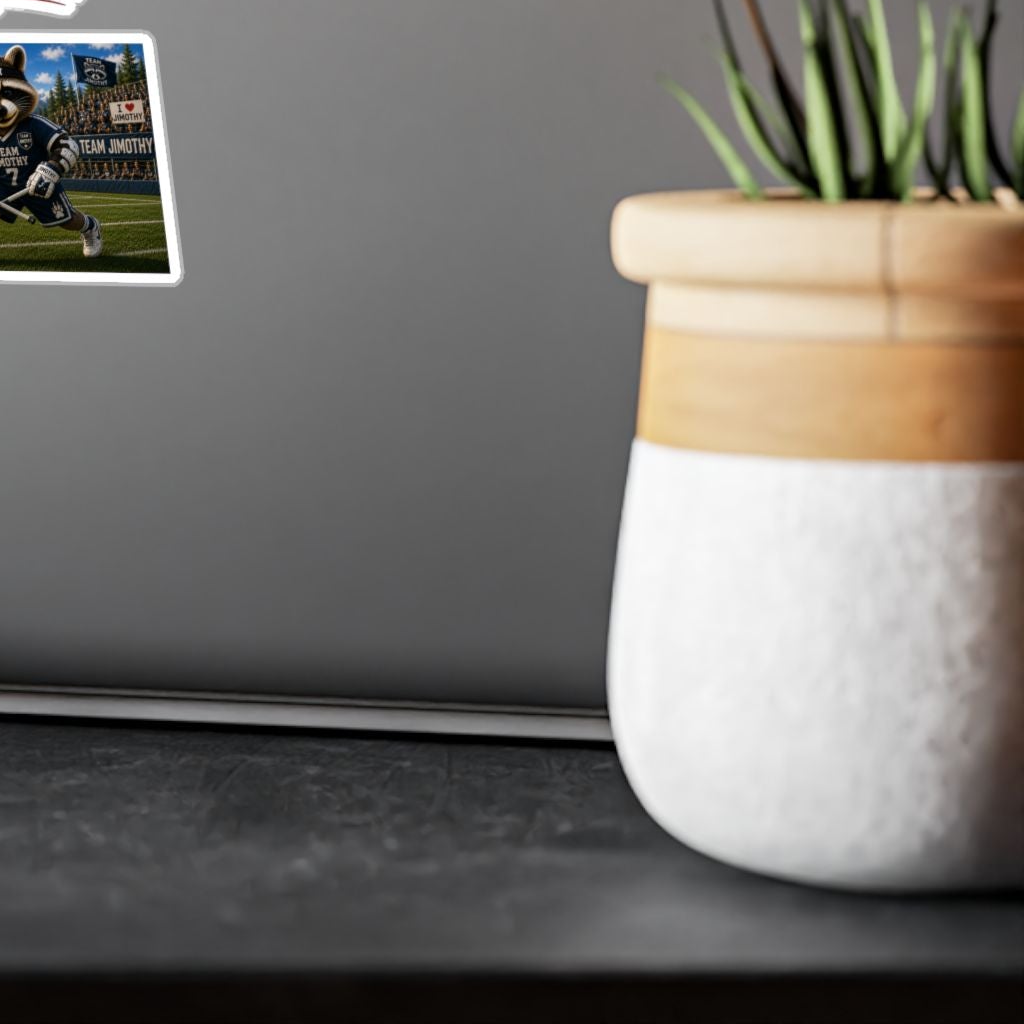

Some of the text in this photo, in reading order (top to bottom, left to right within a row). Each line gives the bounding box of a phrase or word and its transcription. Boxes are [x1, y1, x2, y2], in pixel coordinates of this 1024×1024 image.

[85, 57, 102, 65] TEAM
[117, 103, 123, 112] I
[113, 113, 143, 122] JIMOTHY
[79, 137, 153, 154] TEAM JIMOTHY
[5, 168, 19, 186] 7
